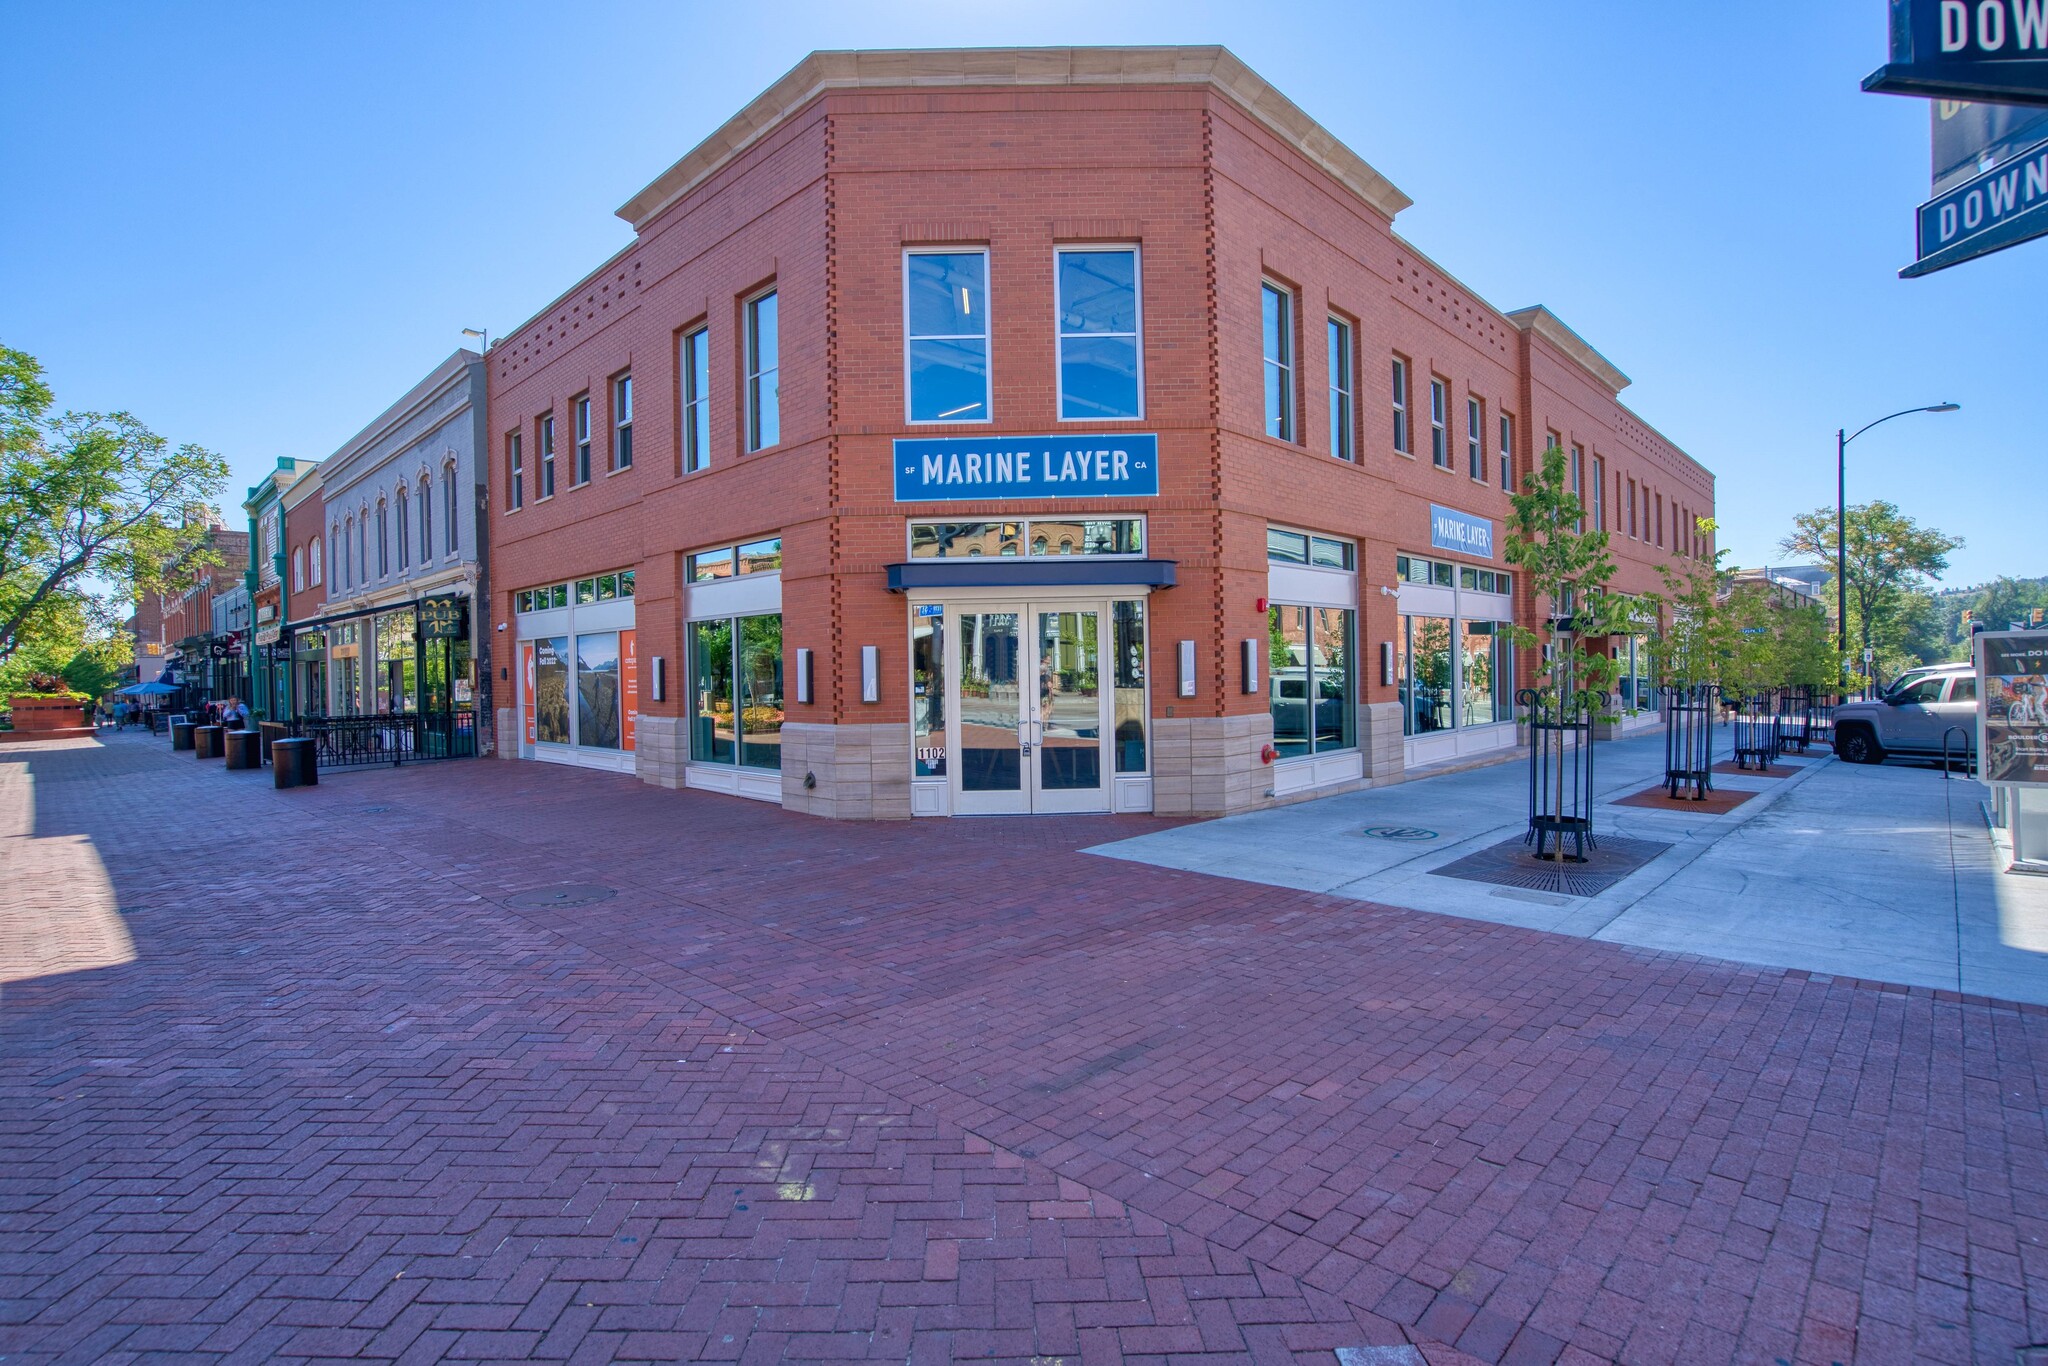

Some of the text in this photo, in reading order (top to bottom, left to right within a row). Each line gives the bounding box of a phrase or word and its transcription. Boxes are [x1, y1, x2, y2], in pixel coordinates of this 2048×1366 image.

[1939, 153, 2048, 243] DOWN
[904, 450, 1147, 485] SF MARINE LAYER CA
[1438, 516, 1487, 547] MARINE LAYER
[421, 610, 460, 620] PUB
[539, 646, 554, 656] Coming
[919, 747, 945, 759] 1102
